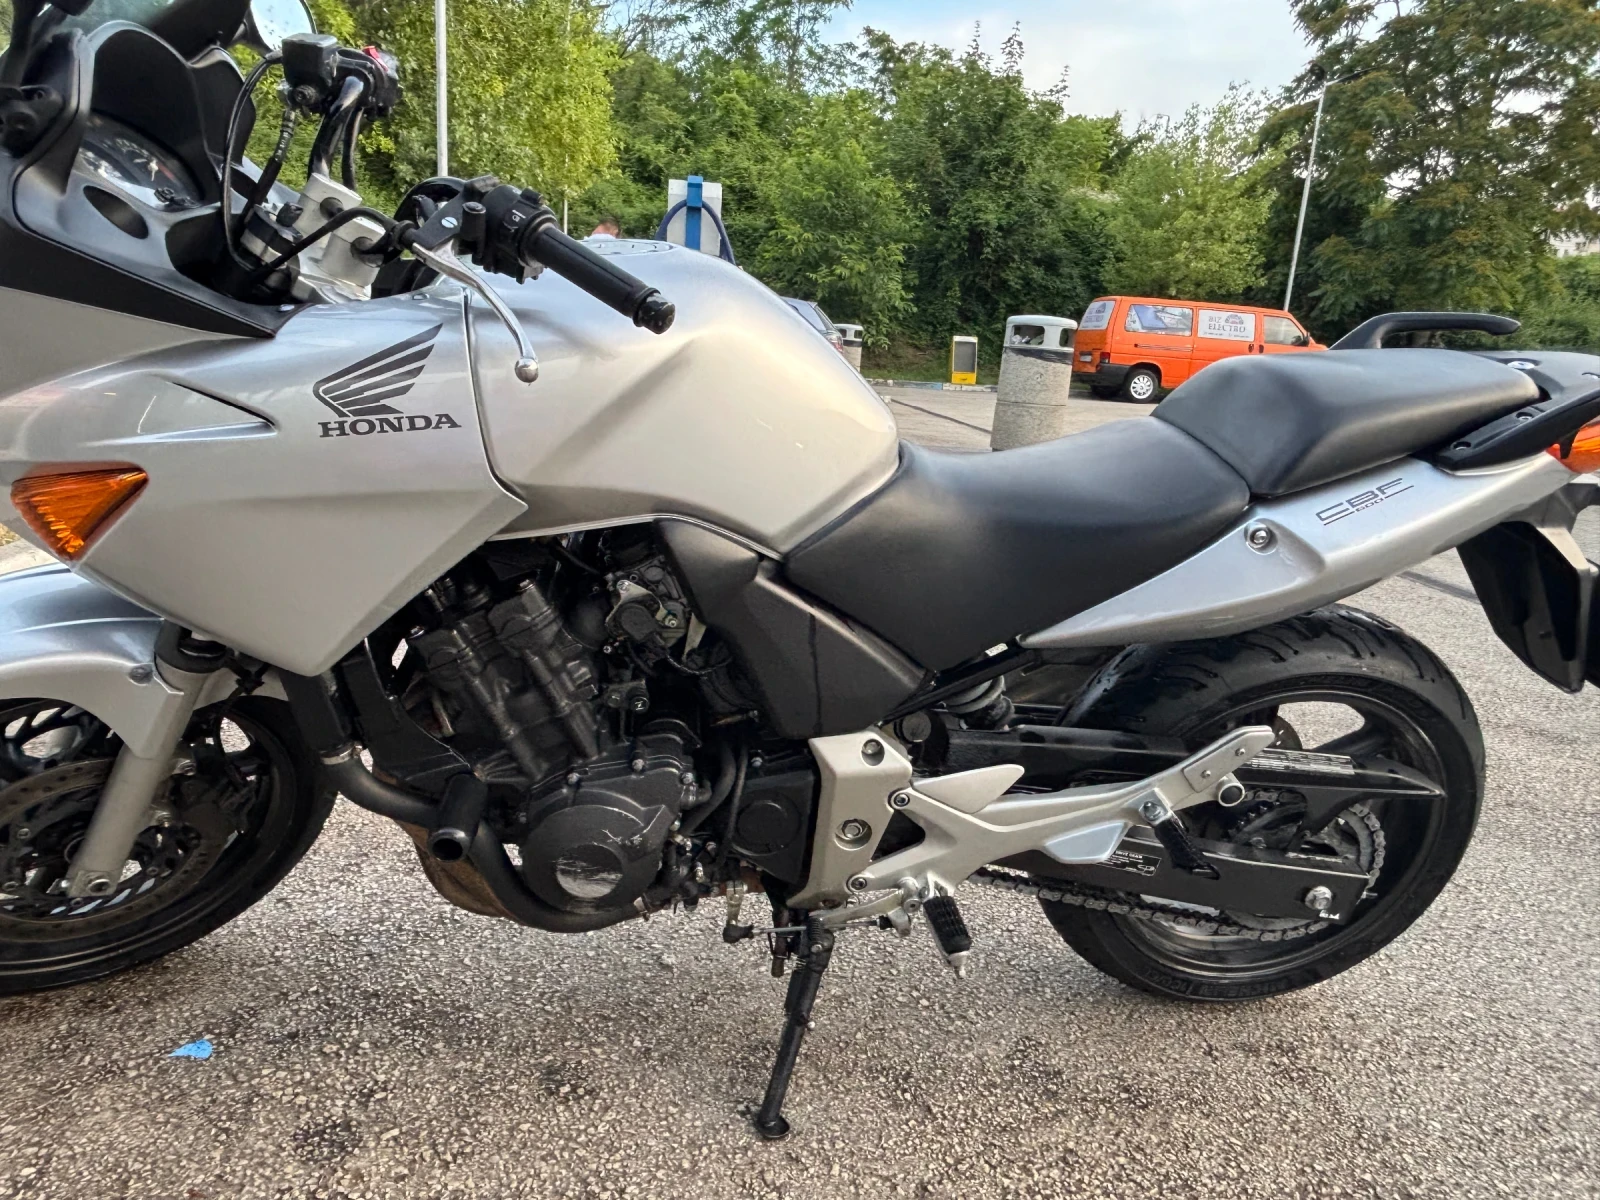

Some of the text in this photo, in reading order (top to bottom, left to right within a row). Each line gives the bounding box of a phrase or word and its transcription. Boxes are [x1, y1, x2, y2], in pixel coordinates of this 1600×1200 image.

[1208, 323, 1246, 333] ELECTRO
[318, 413, 462, 438] HONDA
[1315, 477, 1403, 521] CBF
